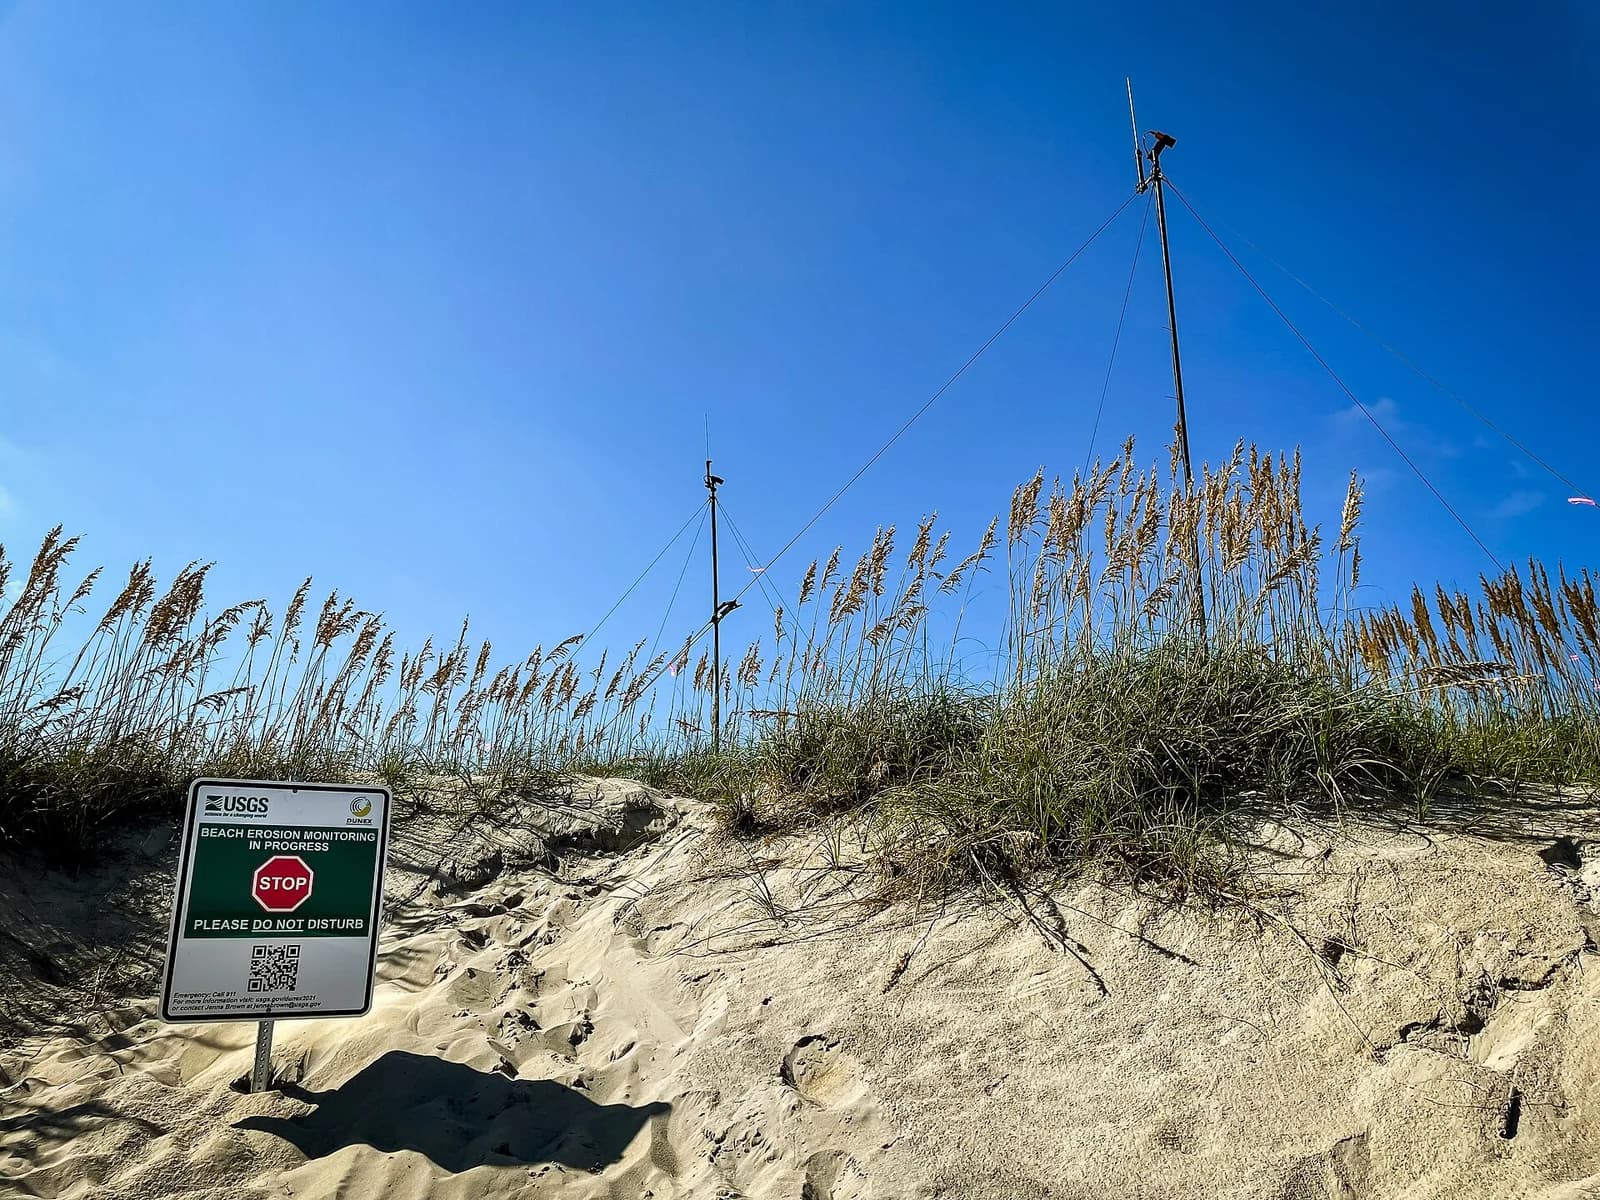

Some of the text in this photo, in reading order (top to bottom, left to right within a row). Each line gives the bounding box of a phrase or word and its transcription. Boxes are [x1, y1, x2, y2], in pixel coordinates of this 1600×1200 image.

[224, 796, 269, 812] USGS
[201, 828, 376, 842] BEACH EROSION MONITORING
[249, 841, 329, 851] IN PROGRESS
[259, 876, 307, 890] STOP
[194, 918, 364, 930] PLEASE DO NOT DISTURB
